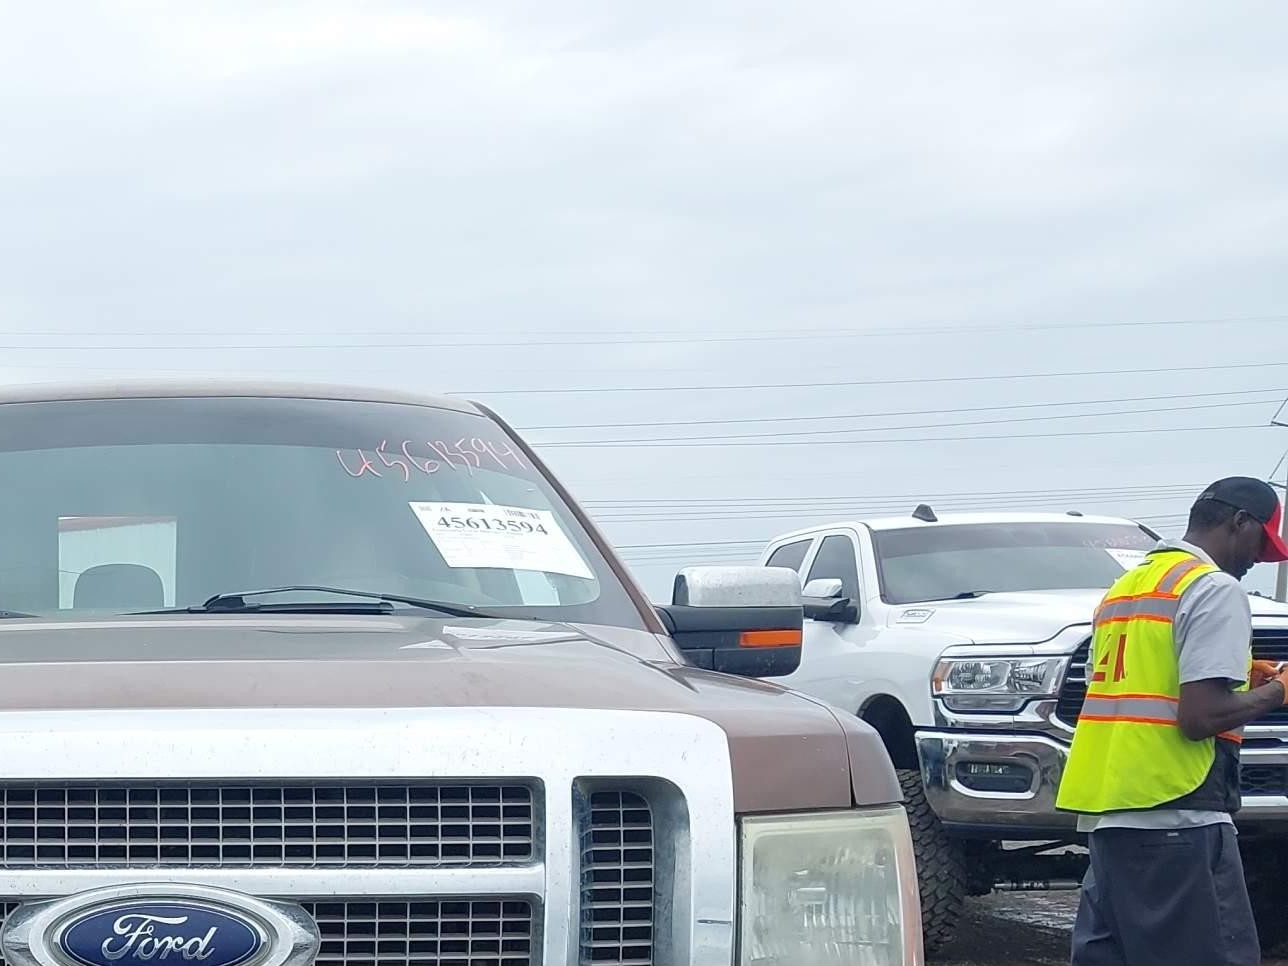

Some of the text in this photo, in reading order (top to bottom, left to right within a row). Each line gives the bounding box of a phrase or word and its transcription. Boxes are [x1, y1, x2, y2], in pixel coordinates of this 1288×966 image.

[336, 438, 528, 482] 45613594
[437, 516, 549, 536] 45613594
[101, 914, 217, 961] Ford
